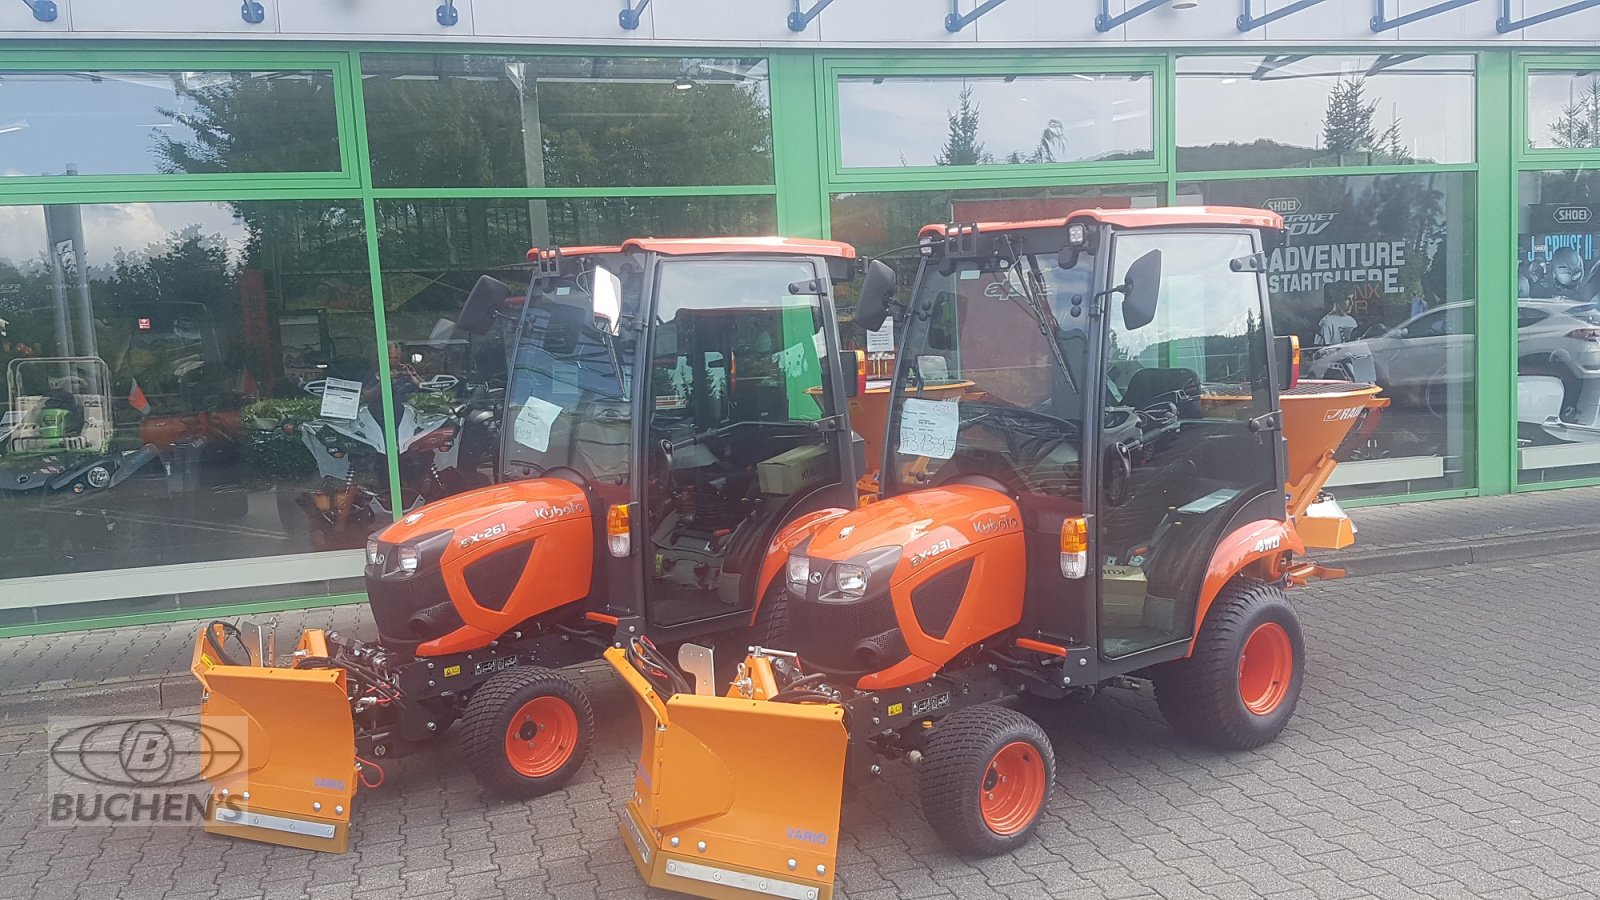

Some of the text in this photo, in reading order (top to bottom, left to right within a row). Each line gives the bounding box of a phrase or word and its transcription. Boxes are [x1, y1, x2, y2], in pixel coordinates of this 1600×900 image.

[1267, 199, 1297, 212] SHOEI
[1283, 212, 1341, 222] ORNET
[1558, 209, 1588, 221] SHOEI
[1269, 241, 1406, 273] ADVENTURE
[534, 501, 584, 520] Kubota
[972, 515, 1019, 535] Kubota
[910, 538, 952, 568] EX-231
[1254, 535, 1280, 553] 4WD
[313, 775, 346, 791] VARIO
[786, 825, 829, 846] VARIO
